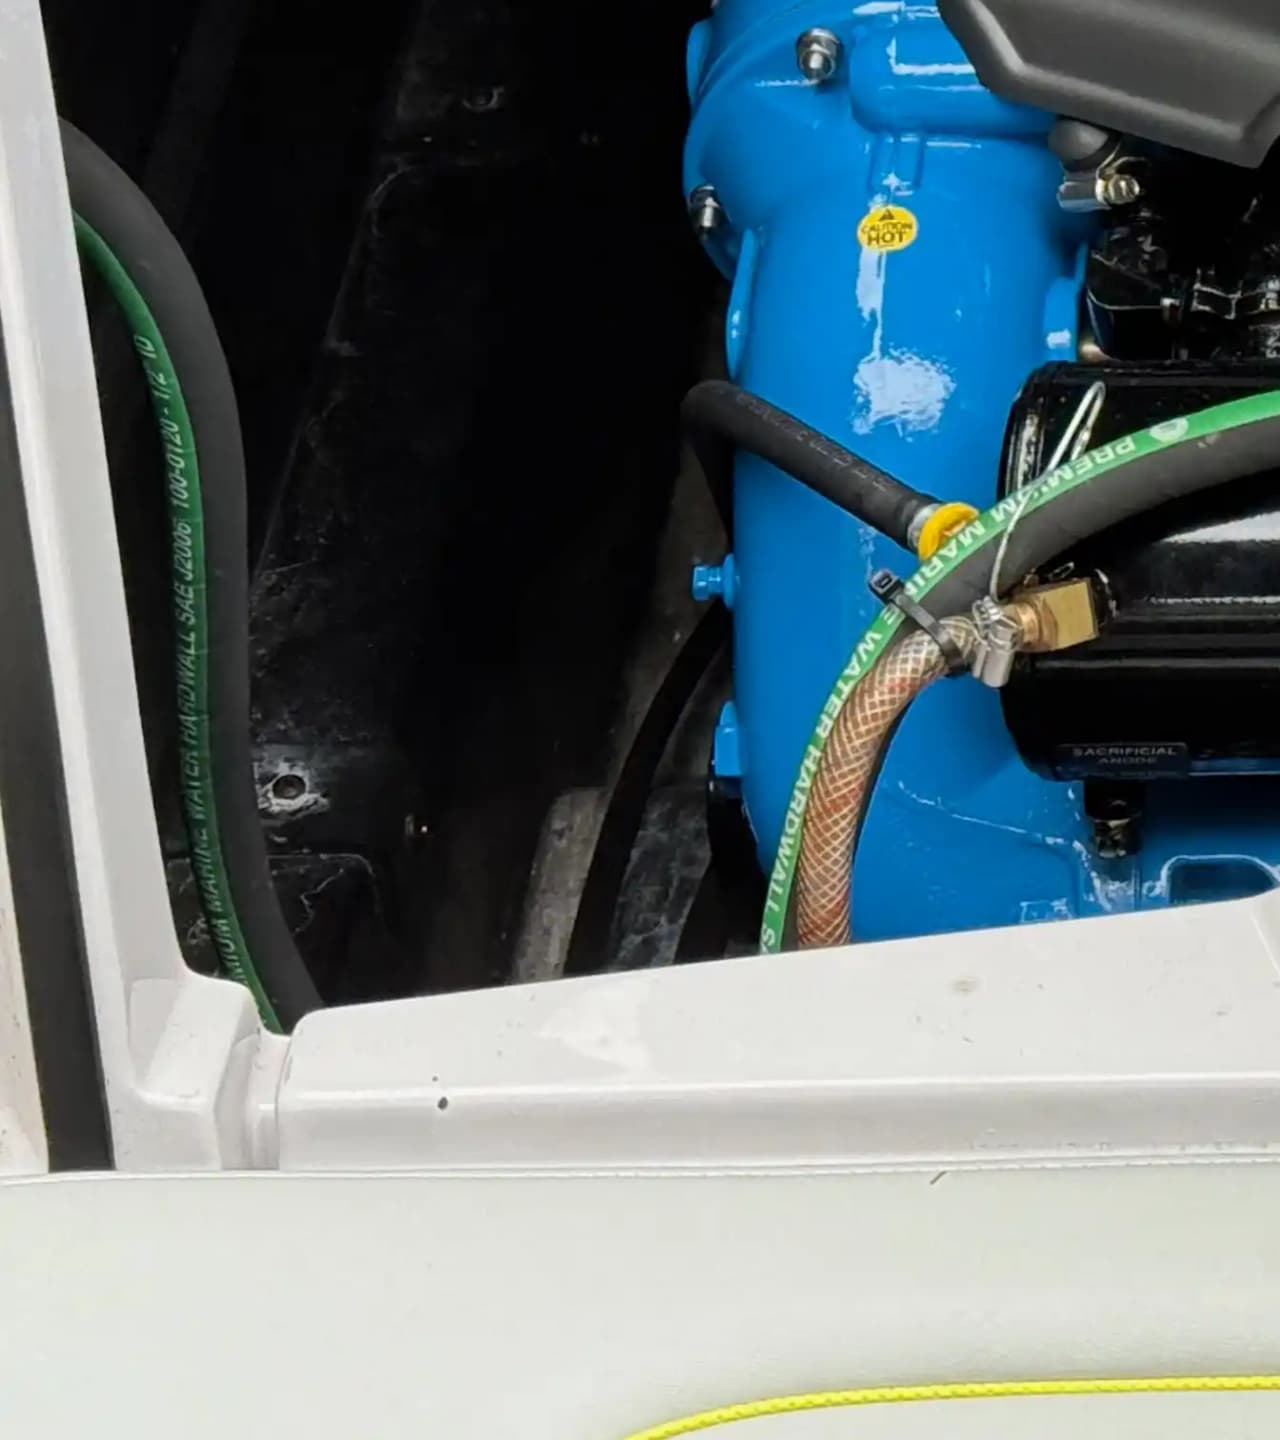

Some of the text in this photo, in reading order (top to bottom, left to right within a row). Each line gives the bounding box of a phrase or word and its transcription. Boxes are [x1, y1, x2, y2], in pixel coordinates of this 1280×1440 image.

[861, 221, 913, 234] CAUTION
[867, 230, 905, 246] HOT
[133, 334, 157, 359] ID
[159, 417, 190, 509] 100-0120
[172, 517, 192, 581] J2006
[174, 582, 196, 625] SAE
[176, 631, 199, 745] HARDWALL
[815, 630, 882, 740] WATER
[184, 747, 207, 820] WATER
[1073, 747, 1177, 757] SACRIFICIAL
[764, 745, 822, 913] HARDWALL
[213, 916, 249, 986] MIUM
